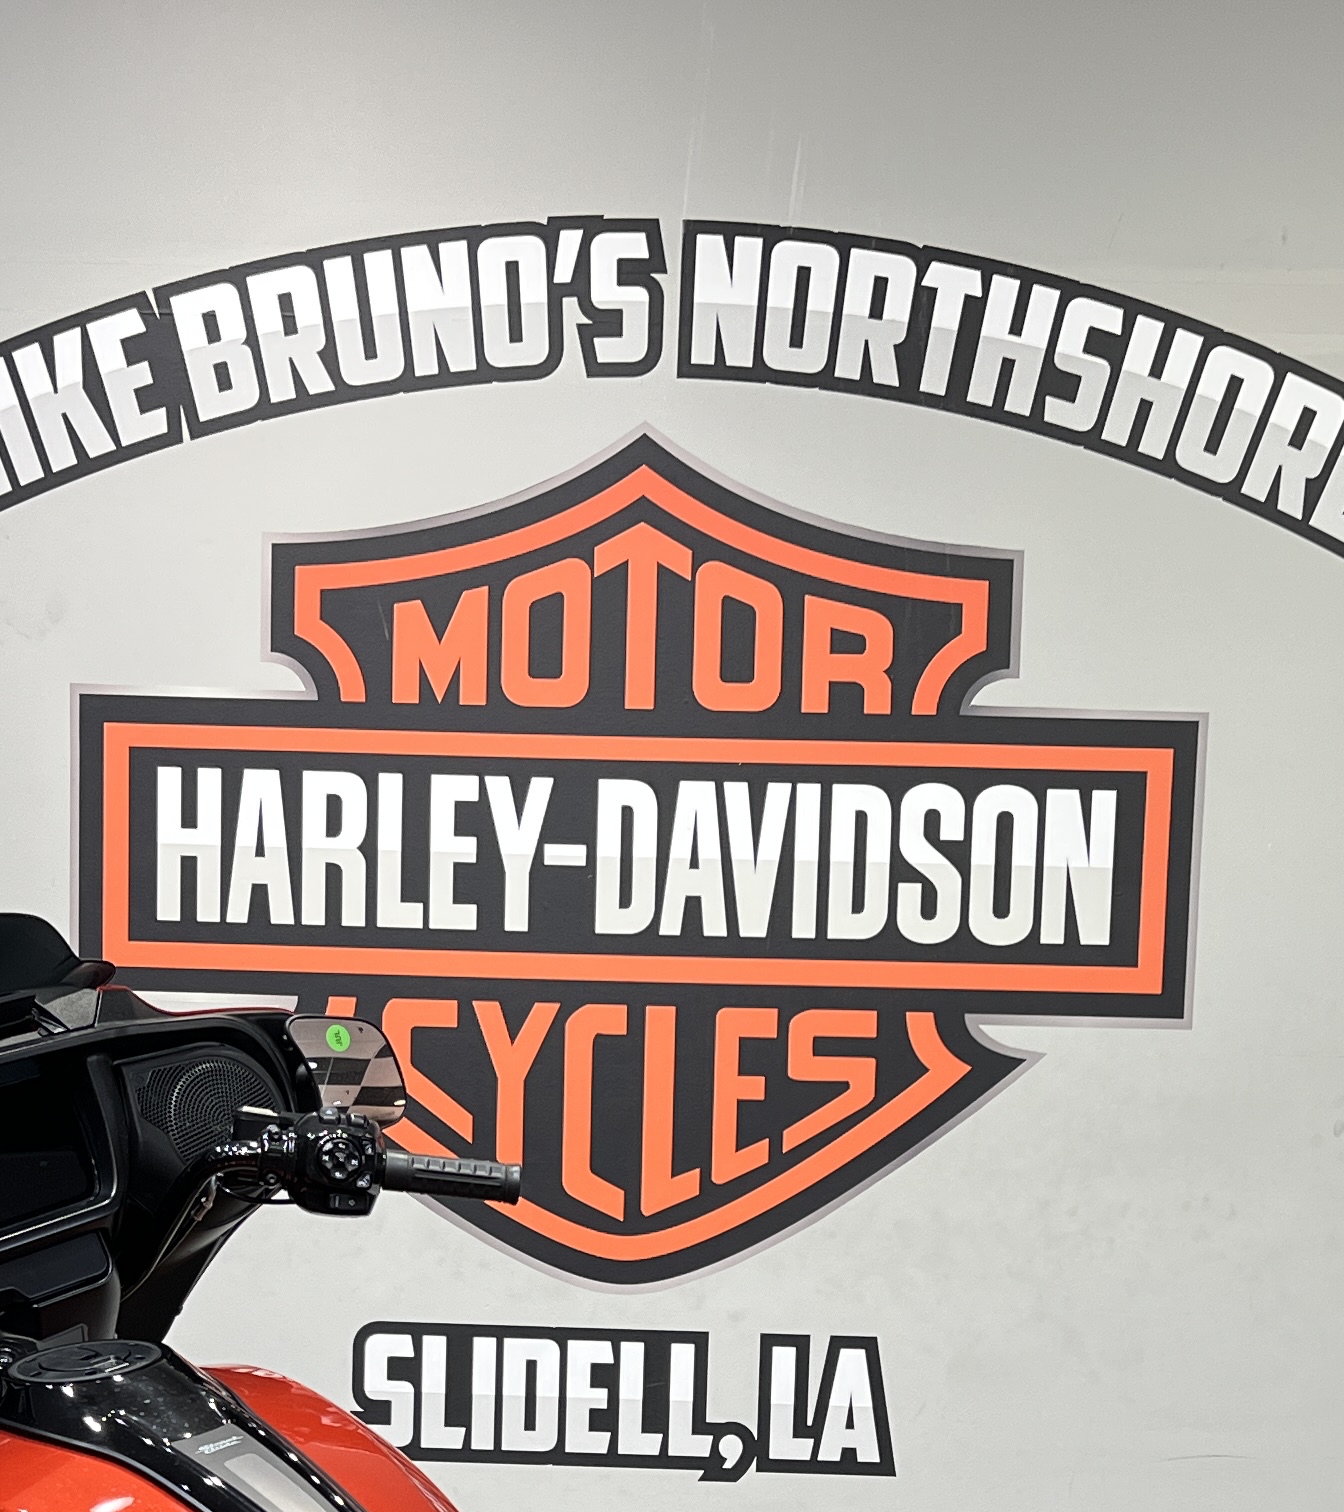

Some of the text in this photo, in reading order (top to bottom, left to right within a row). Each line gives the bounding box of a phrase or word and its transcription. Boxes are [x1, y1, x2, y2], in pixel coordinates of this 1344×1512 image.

[167, 227, 652, 424] BRUNO'S
[390, 521, 893, 716] MOTOR
[154, 765, 1117, 948] HARLEY-DAVIDSON
[379, 996, 878, 1223] CYCLES
[768, 1345, 882, 1464] LA
